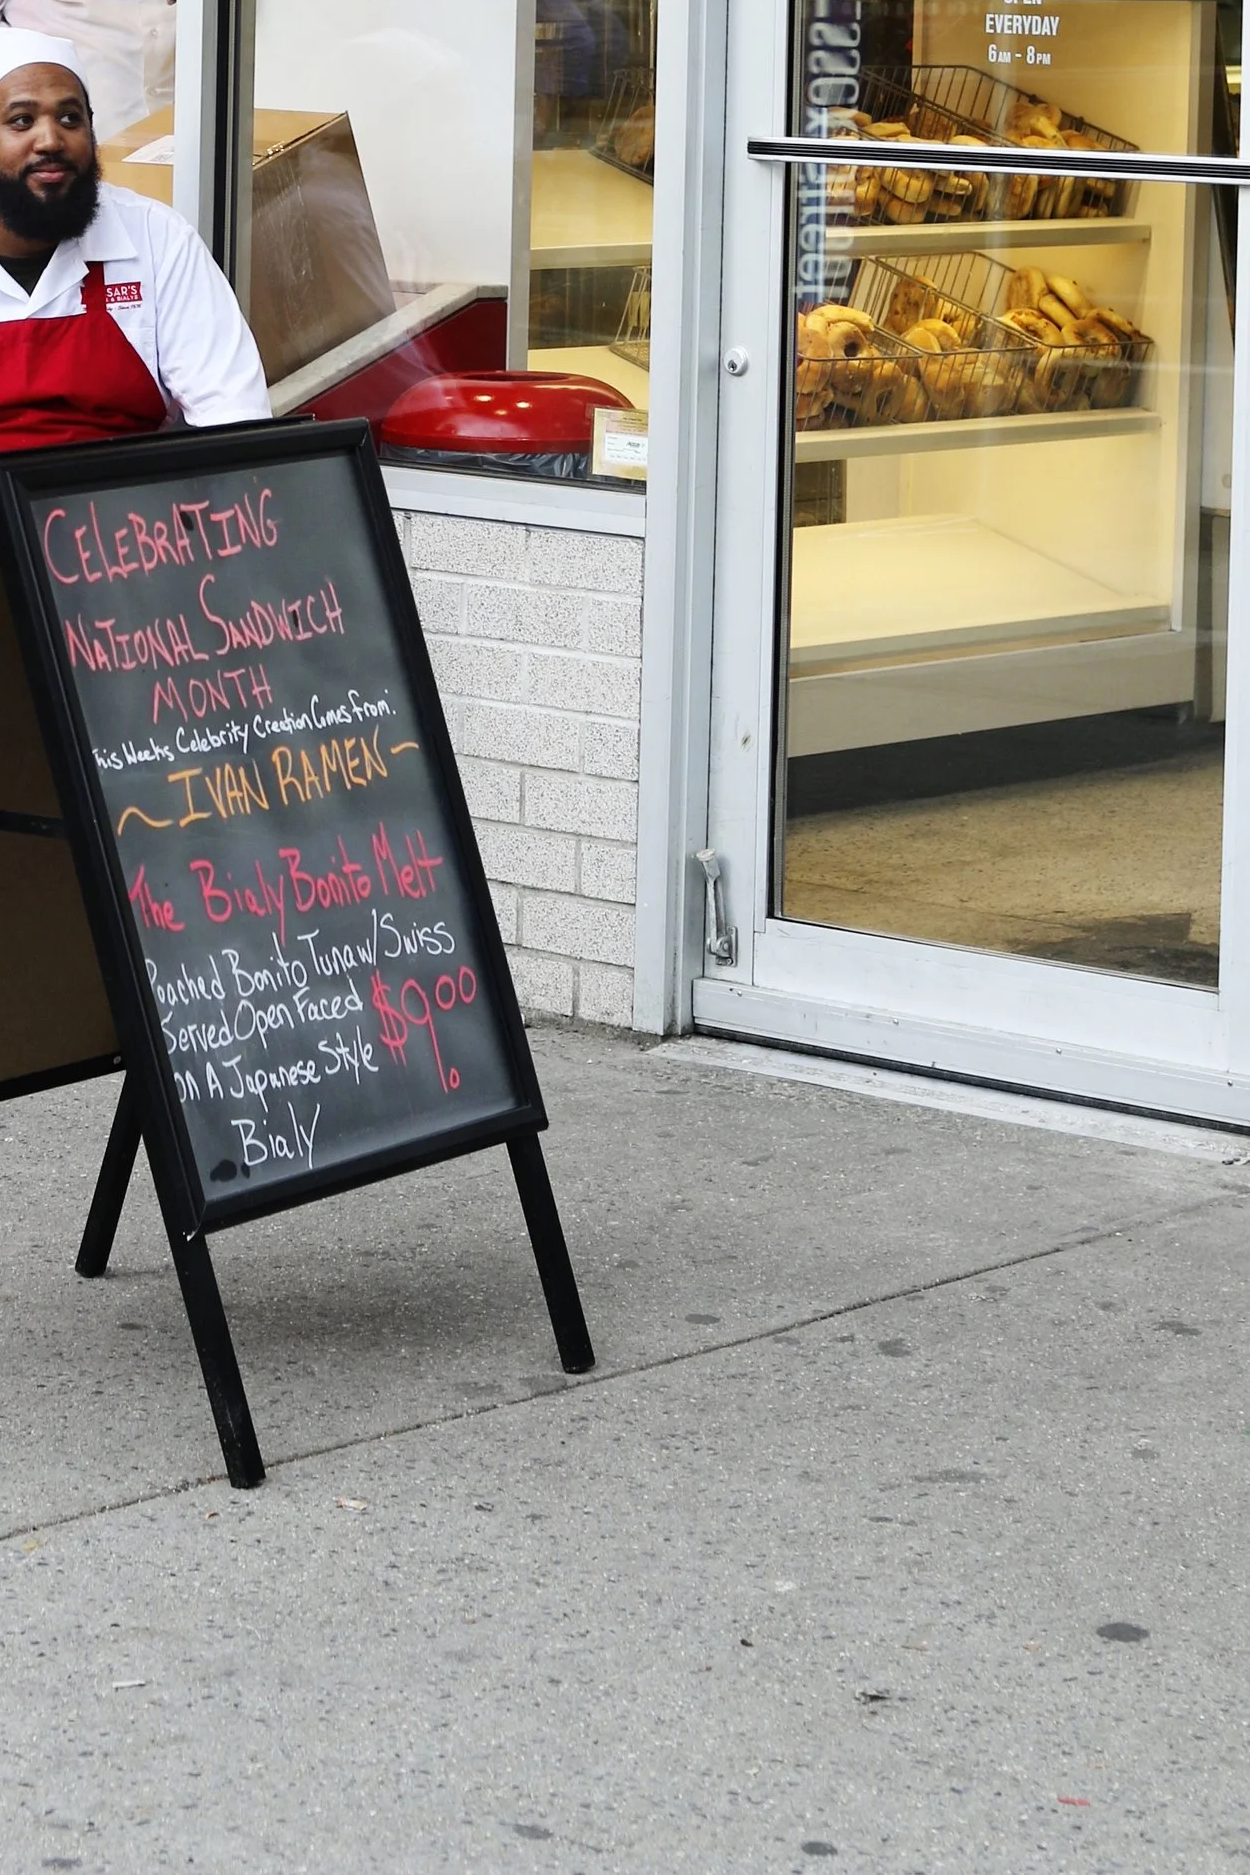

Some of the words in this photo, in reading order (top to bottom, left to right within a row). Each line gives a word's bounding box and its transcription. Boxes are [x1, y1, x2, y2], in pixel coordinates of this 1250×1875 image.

[985, 13, 1060, 37] EVERYDAY
[43, 489, 278, 585] CELEBRATING
[64, 613, 210, 673] NATIONAL
[198, 574, 345, 656] SANDWICH
[152, 664, 274, 725] MONTH
[176, 720, 249, 754] Celebrity
[252, 706, 314, 739] Creation
[167, 758, 270, 828] IVAN
[271, 724, 389, 807] RAMEN
[127, 863, 186, 931] The
[189, 859, 286, 948] Bialy
[279, 835, 372, 914] Bonito
[371, 821, 444, 900] Melt
[221, 932, 309, 998] Bonito
[297, 929, 358, 977] Tuna
[161, 1009, 234, 1056] Served
[233, 998, 294, 1050] Open
[292, 975, 364, 1025] Faced
[205, 1061, 225, 1101] A
[221, 1054, 322, 1113] Japanese
[317, 1025, 380, 1086] Style
[230, 1101, 321, 1169] Bialy
